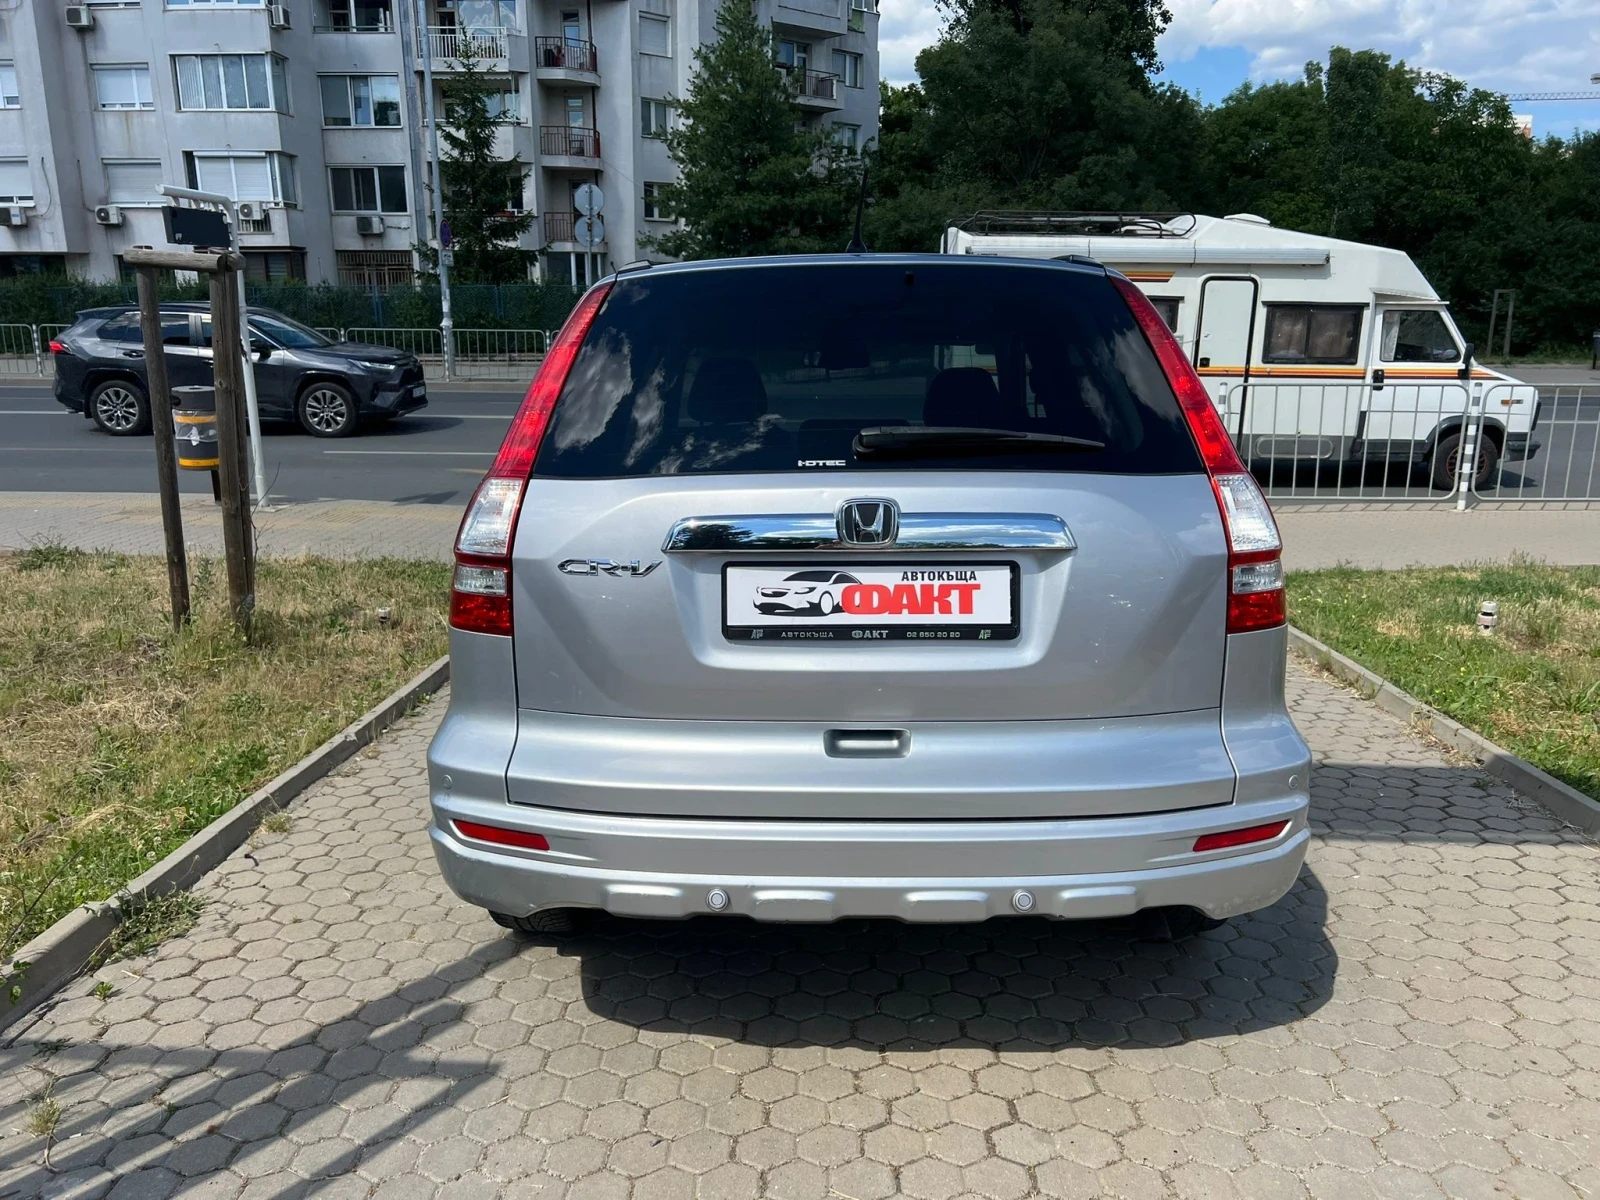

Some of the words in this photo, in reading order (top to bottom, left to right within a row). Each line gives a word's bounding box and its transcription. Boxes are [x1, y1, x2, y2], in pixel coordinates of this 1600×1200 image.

[557, 558, 663, 577] CR-V
[901, 570, 977, 582] АВТОКЪЩА
[841, 583, 981, 615] ФАКТ
[851, 630, 889, 639] ФАКТ
